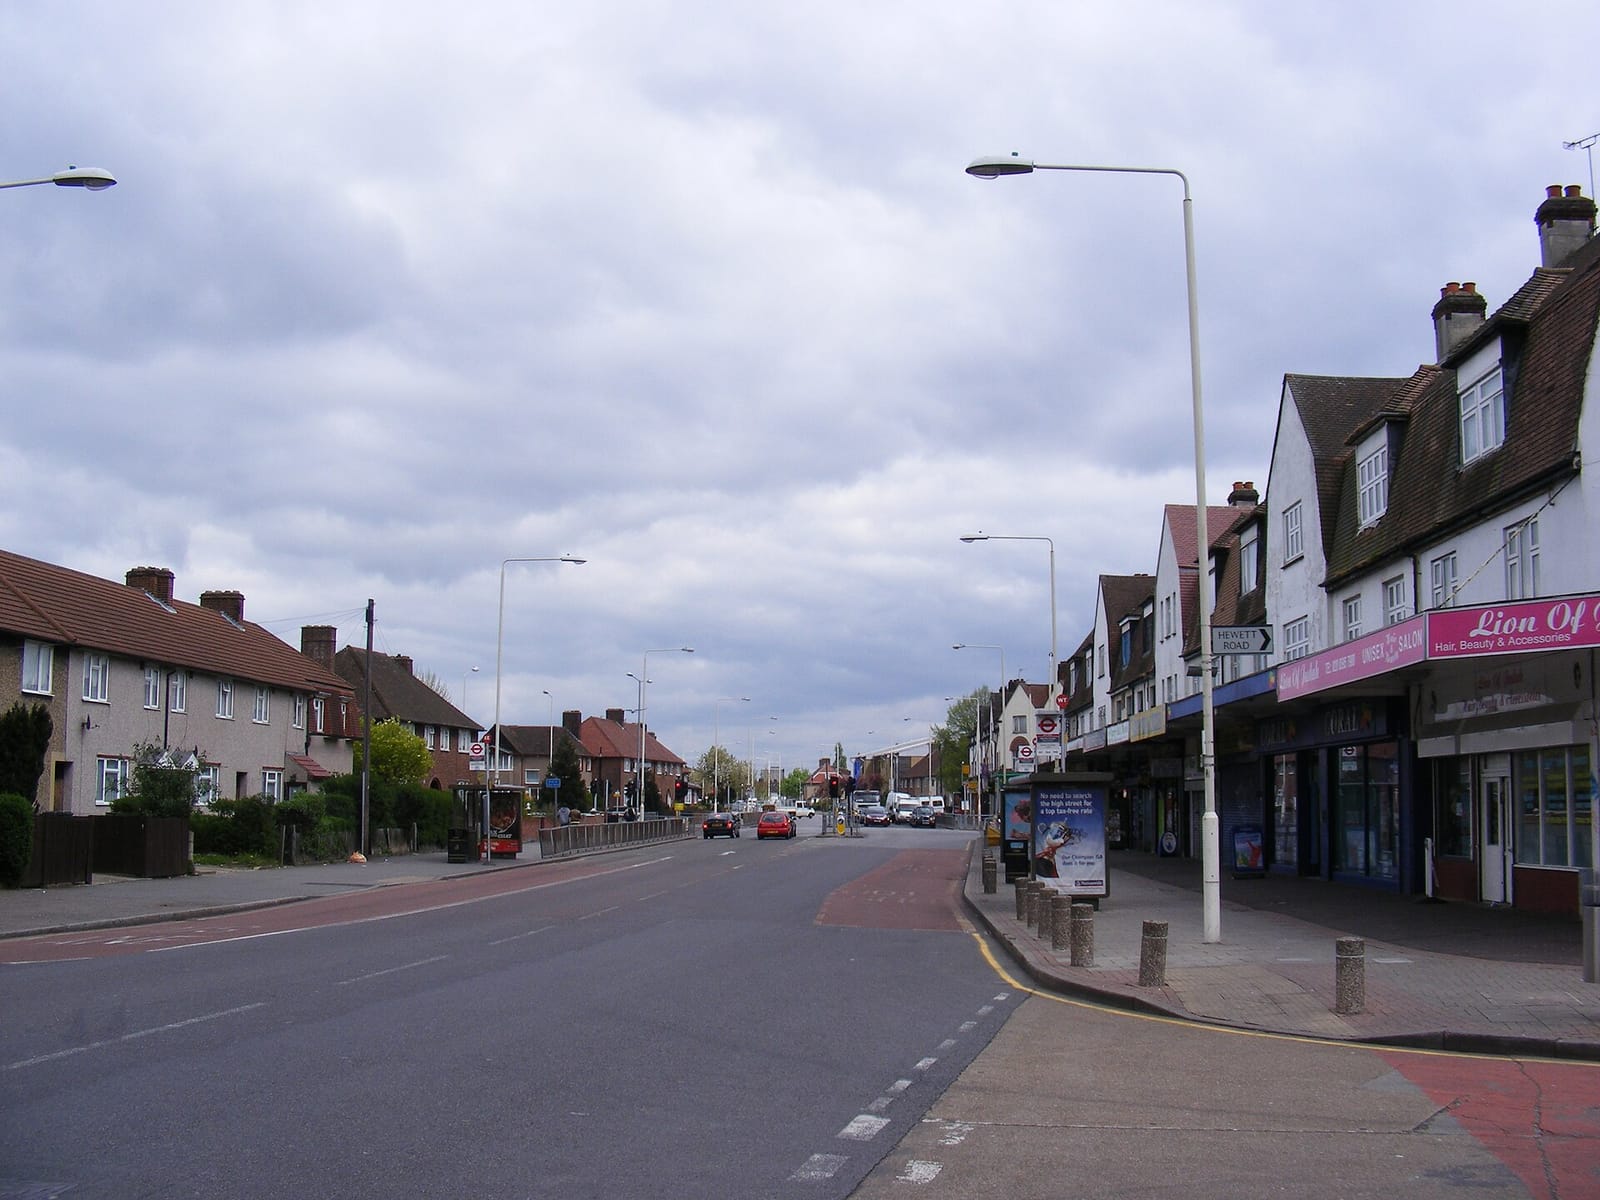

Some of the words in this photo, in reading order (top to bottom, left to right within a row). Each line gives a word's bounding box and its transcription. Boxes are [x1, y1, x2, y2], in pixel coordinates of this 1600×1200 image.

[1469, 610, 1537, 637] Lion
[1547, 600, 1586, 634] Of
[1218, 631, 1257, 640] HEWETT
[1223, 641, 1250, 650] ROAD
[1398, 628, 1423, 653] SALON
[1435, 642, 1457, 652] Hair,
[1460, 639, 1494, 651] Beauty
[1497, 636, 1505, 647] &
[1508, 632, 1571, 646] Accessories
[1362, 642, 1385, 665] UNISEX
[1325, 706, 1359, 736] CORAL
